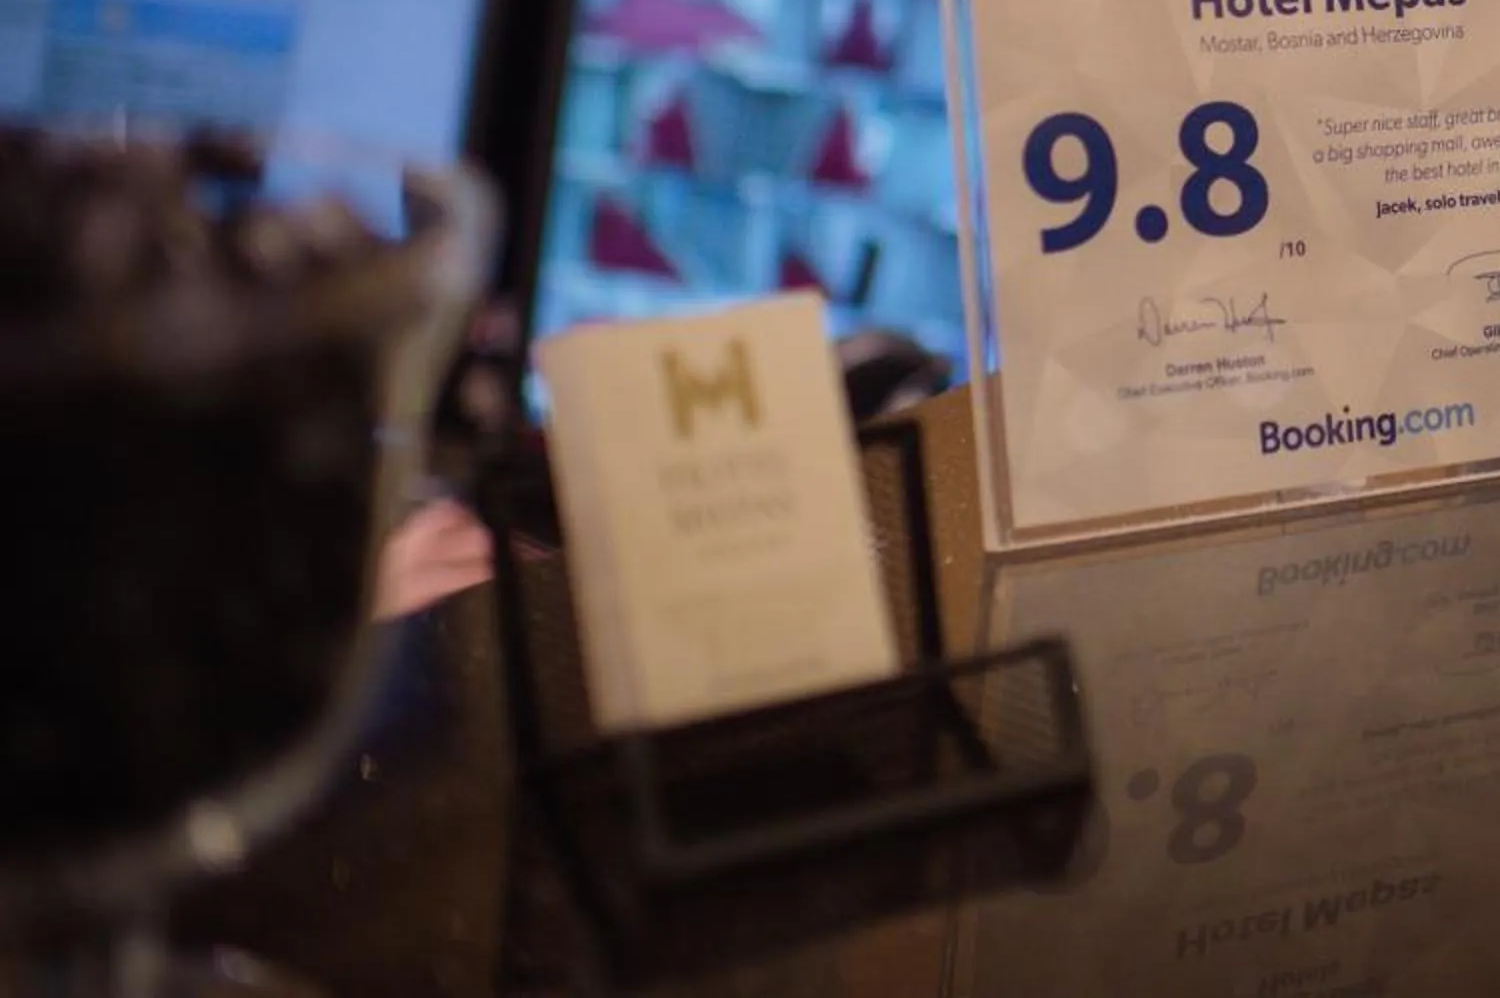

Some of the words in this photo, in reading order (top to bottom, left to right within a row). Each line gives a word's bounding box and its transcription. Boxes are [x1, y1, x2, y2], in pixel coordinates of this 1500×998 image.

[1199, 35, 1263, 53] Mostar,
[1267, 30, 1324, 51] Bosnia
[1326, 27, 1360, 47] and
[1361, 23, 1466, 47] Herzegovina
[1371, 116, 1403, 132] nice
[1444, 108, 1484, 131] great
[1312, 149, 1325, 165] a
[1327, 145, 1353, 165] big
[1356, 140, 1429, 162] shopping
[1431, 134, 1468, 153] mall,
[1022, 100, 1269, 254] 9.8
[1384, 164, 1409, 184] the
[1413, 163, 1443, 181] best
[1447, 159, 1483, 177] hotel
[1487, 158, 1500, 174] in
[1376, 197, 1422, 219] Jacek,
[1425, 194, 1457, 211] solo
[1278, 239, 1307, 259] /10
[1259, 402, 1476, 455] Booking.com
